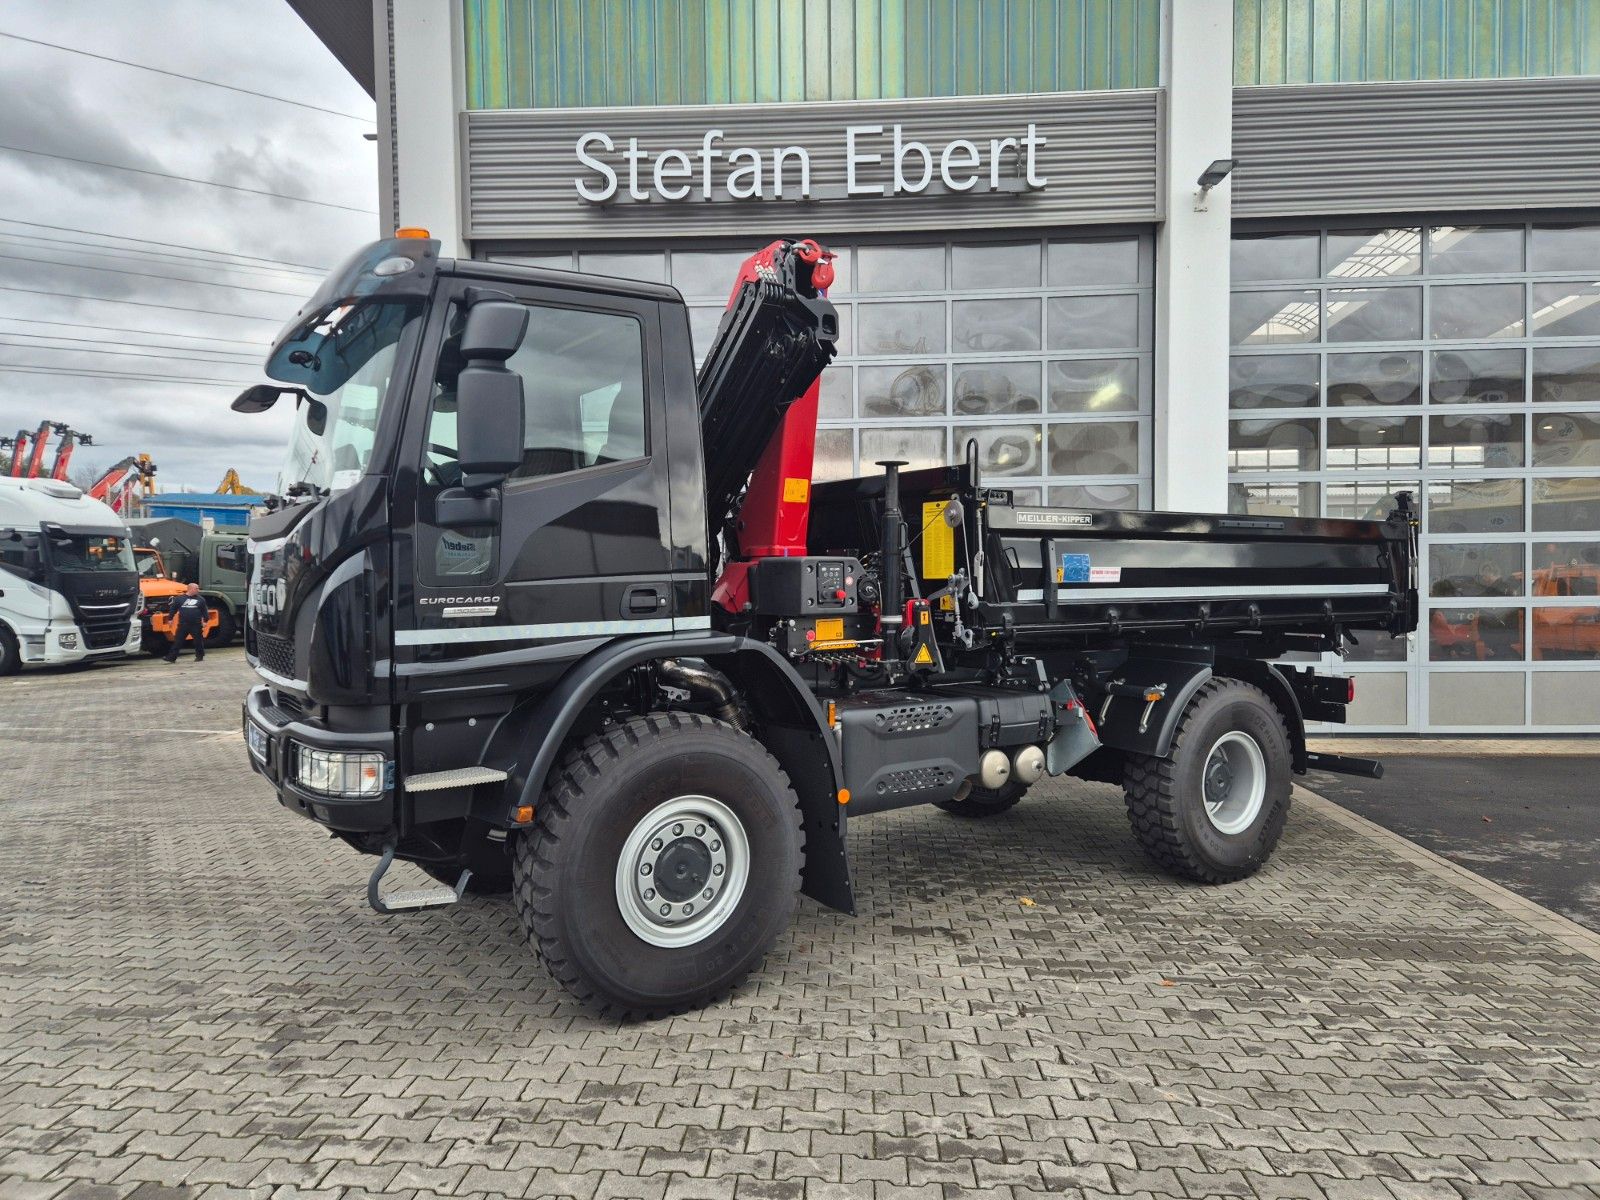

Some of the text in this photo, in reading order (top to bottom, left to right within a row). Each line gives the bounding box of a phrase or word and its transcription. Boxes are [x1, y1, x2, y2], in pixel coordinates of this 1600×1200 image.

[574, 123, 1048, 202] Stefan Ebert
[1018, 513, 1091, 524] MEILLER-KIPPER
[419, 595, 501, 605] EUROCARGO
